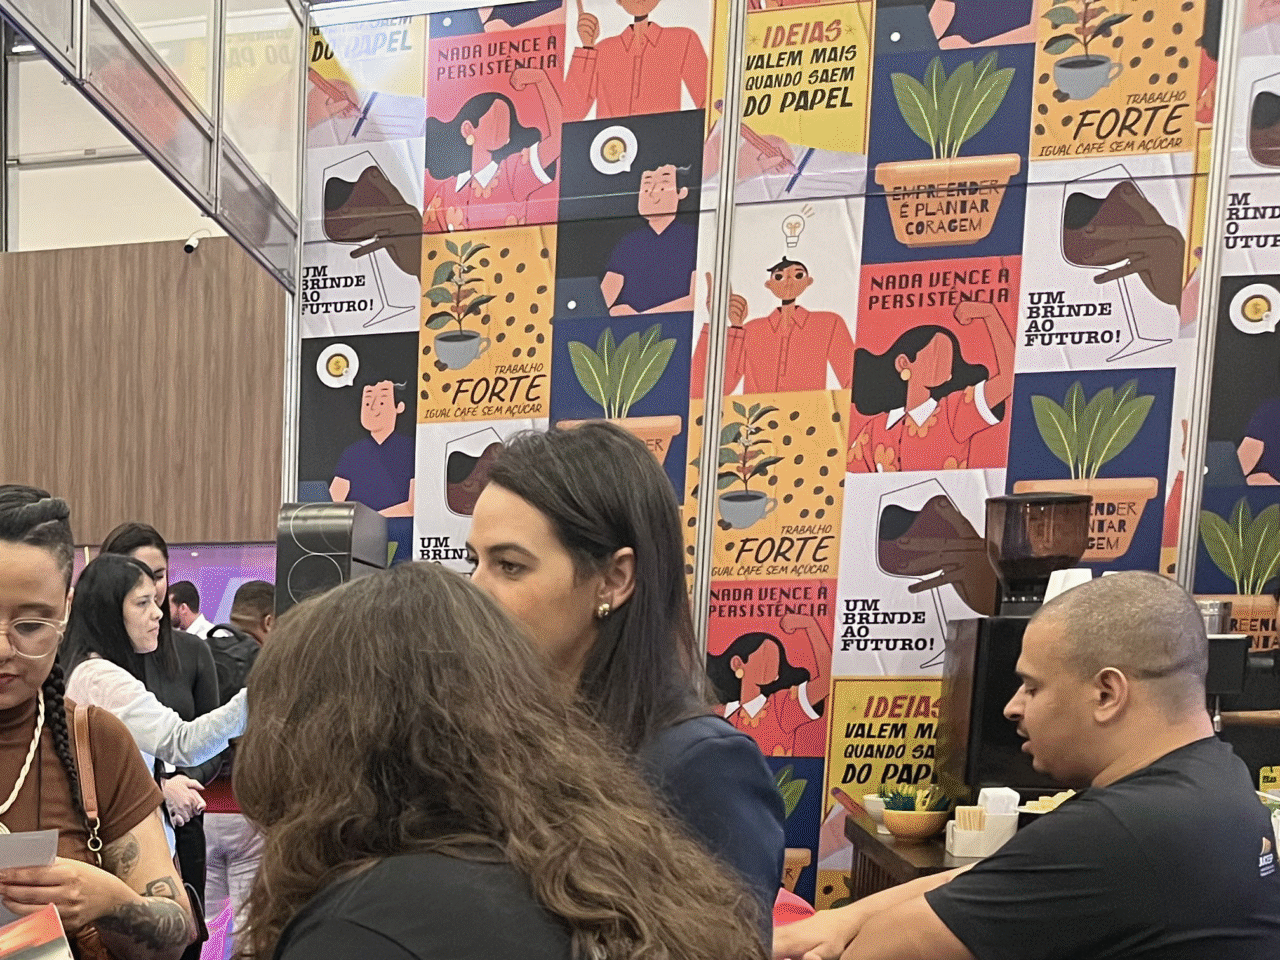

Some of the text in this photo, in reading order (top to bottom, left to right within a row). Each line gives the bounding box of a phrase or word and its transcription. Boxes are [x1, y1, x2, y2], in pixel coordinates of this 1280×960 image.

[763, 19, 842, 49] IDEIAS
[438, 35, 557, 61] NADA VENCE A
[745, 45, 857, 71] VALEM MAIS
[437, 54, 557, 81] PERSISTÊNCIA
[745, 66, 855, 91] QUANDO SAEM
[743, 86, 854, 117] DO PAPEL
[1126, 90, 1187, 105] TRABALHO
[1072, 103, 1190, 141] FORTE
[1038, 136, 1183, 157] IGUAL CAFÉ SEM AÇÚCAR
[892, 179, 1000, 201] EMPREENDER
[1227, 192, 1251, 206] M
[899, 199, 990, 219] É PLANTAR
[1226, 206, 1280, 220] RIND
[905, 218, 983, 236] CORAGEM
[1226, 222, 1239, 235] O
[1224, 235, 1280, 249] UTUR
[870, 267, 1010, 291] NADA VENCE A
[868, 285, 1009, 311] PERSISTÊNCIA
[1028, 290, 1065, 305] UM
[1026, 302, 1112, 319] BRINDE
[1024, 319, 1054, 333] AO
[1024, 330, 1121, 347] FUTURO!
[494, 363, 544, 375] TRABALHO
[452, 374, 547, 405] FORTE
[424, 402, 543, 419] IGUAL CAFÉ SEM AÇÚCAR
[780, 524, 832, 535] TRABALHO
[419, 536, 450, 549] UM
[735, 535, 835, 564] FORTE
[419, 548, 468, 560] BRIN
[711, 563, 830, 577] GUAL CAFÉ SEM AÇÚCAR
[710, 586, 828, 601] NADA VENCE A
[708, 602, 828, 618] PERSISTÊNCIA
[843, 599, 880, 612] UM
[842, 611, 926, 625] BRINDE
[841, 625, 870, 638] AO
[840, 637, 935, 651] FUTURO!
[845, 723, 907, 739] VALEM
[843, 744, 935, 759] QUANDO SA
[841, 763, 932, 785] DO PAP
